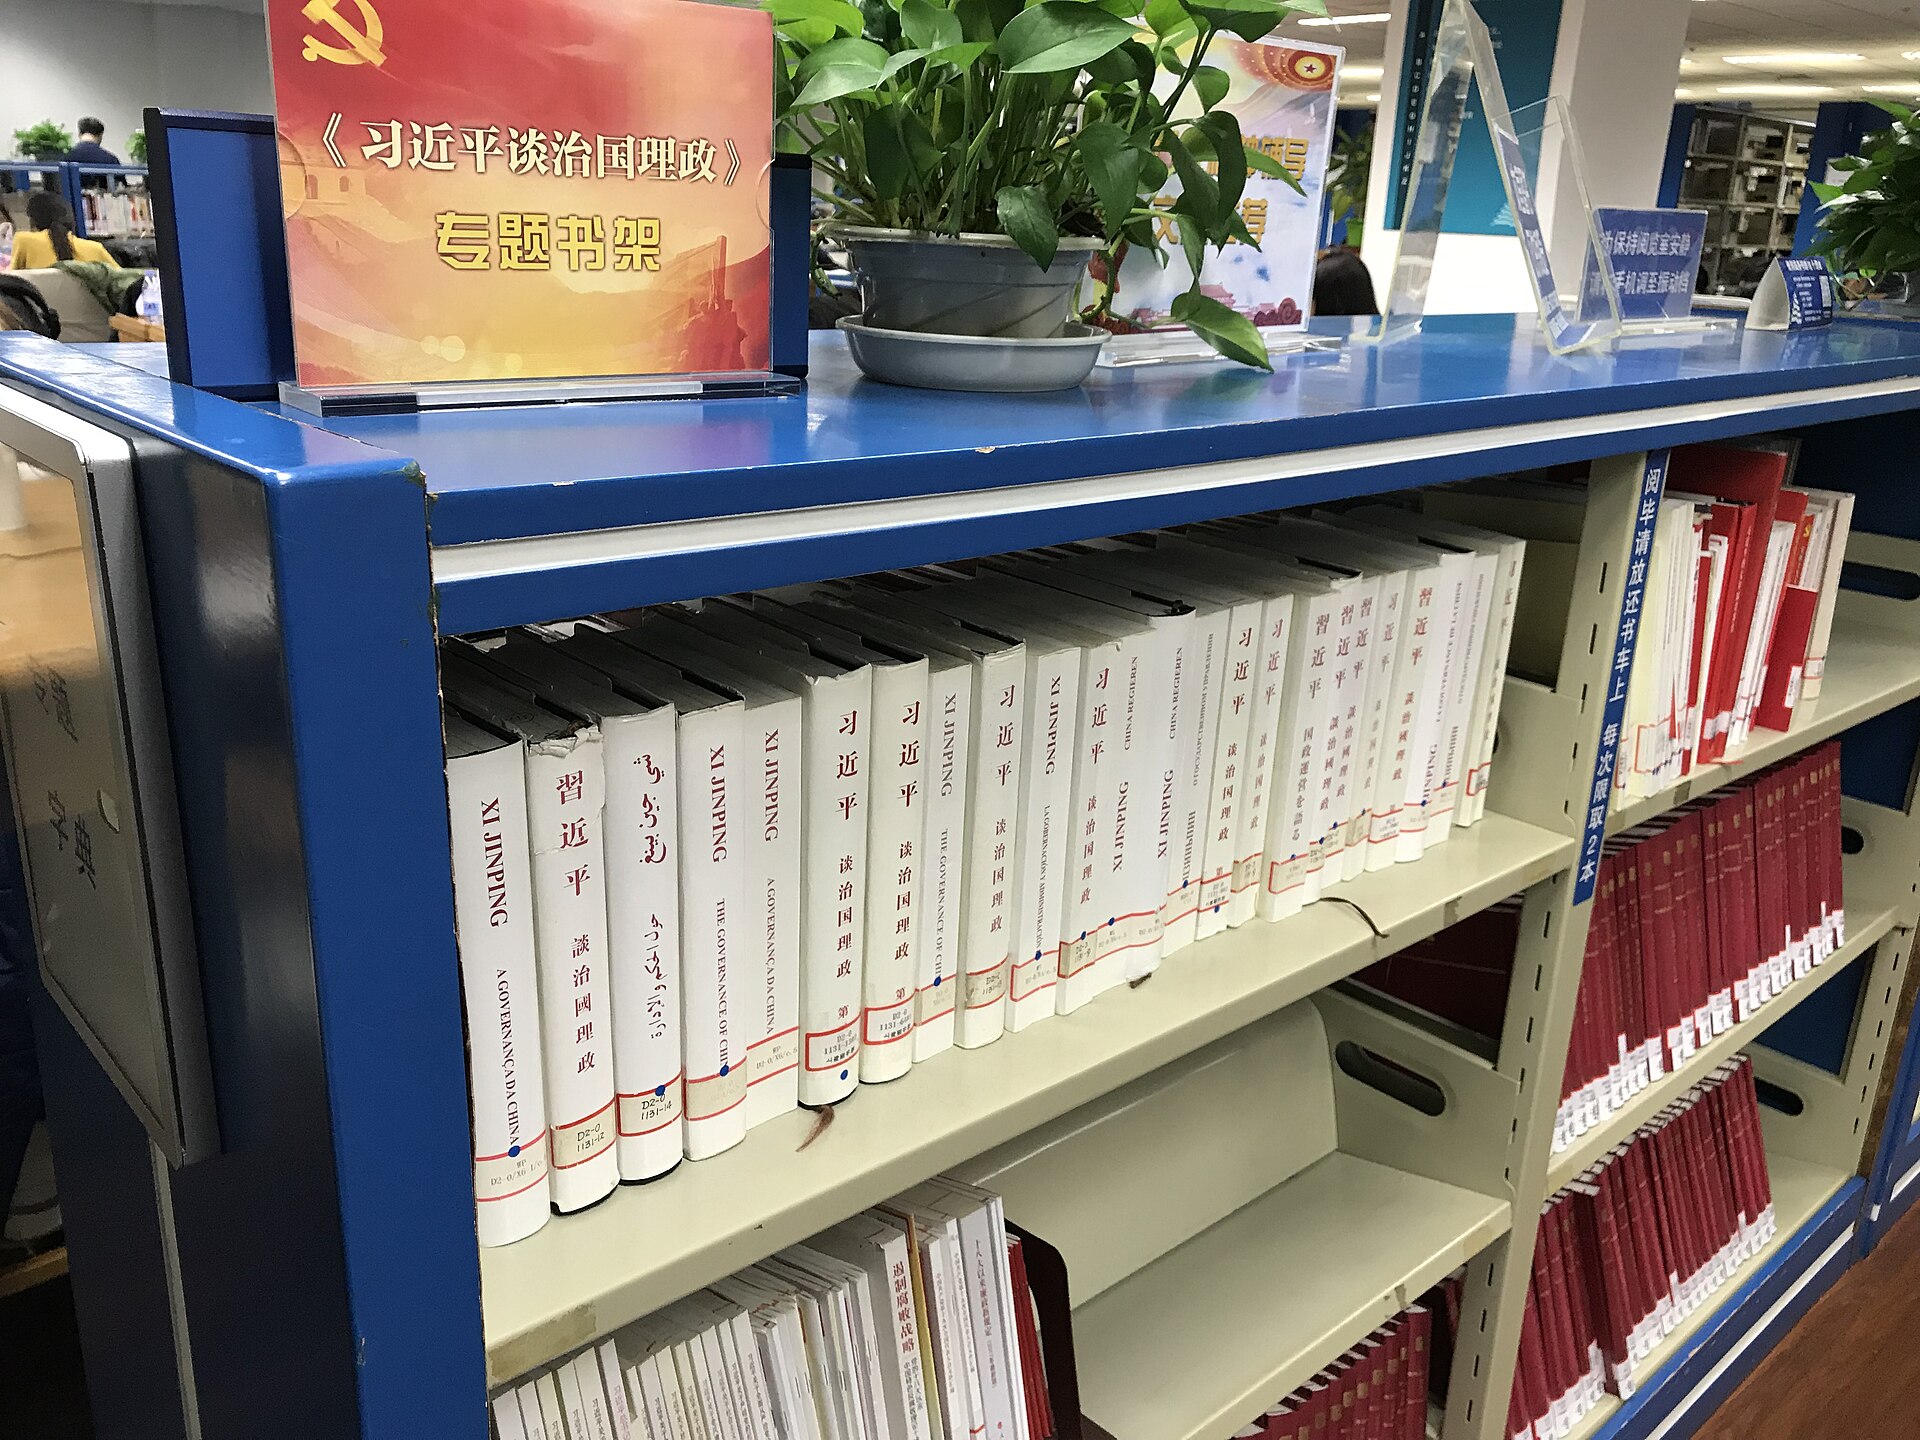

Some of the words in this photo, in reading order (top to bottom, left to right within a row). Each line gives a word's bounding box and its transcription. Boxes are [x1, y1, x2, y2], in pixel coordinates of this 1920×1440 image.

[321, 112, 742, 187] 《习近平谈治国理政》
[435, 210, 662, 272] 专题书架
[1411, 586, 1433, 666] 習近平
[1609, 468, 1662, 703] 阅毕请放还书车上
[1233, 627, 1253, 715] 习近平
[1264, 618, 1284, 705] 习近平
[1309, 613, 1330, 700] 習近平
[1335, 604, 1355, 689] 習近平
[1353, 596, 1373, 680] 習近平
[945, 692, 957, 715] XI
[1050, 675, 1062, 697] XI
[1091, 668, 1110, 765] 习近平
[710, 744, 725, 771] XI
[765, 728, 779, 753] XI
[835, 710, 859, 821] 习近平
[897, 700, 921, 808] 习近平
[940, 721, 956, 797] JINPING
[995, 684, 1016, 787] 习近平
[1045, 702, 1060, 776] JINPING
[481, 797, 501, 827] XI
[556, 769, 591, 896] 習近平
[711, 776, 728, 864] JINPING
[764, 759, 779, 842] JINPING
[1113, 781, 1130, 851] JINPING
[1159, 769, 1174, 843] JINPING
[1218, 742, 1238, 842] 谈治国理政
[1578, 723, 1620, 884] 每次限取2本
[483, 830, 509, 928] JINPING
[940, 828, 949, 854] THE
[990, 818, 1007, 933] 谈治国理政
[1080, 795, 1097, 905] 谈治国理政
[1113, 855, 1124, 873] XI
[1157, 842, 1168, 860] XI
[716, 898, 726, 927] THE
[766, 888, 776, 975] GOVERNANÇA
[836, 855, 854, 978] 谈治国理政
[894, 840, 914, 961] 谈治国理政
[936, 855, 949, 937] GOVERNANCE
[571, 934, 596, 1075] 談治國理政
[716, 928, 728, 1015] GOVERNANCE
[497, 980, 517, 1077] GOVERNANÇA
[718, 1016, 728, 1036] OF
[766, 996, 776, 1035] CHINA
[506, 1101, 521, 1146] CHINA
[576, 1131, 606, 1153] 1131-12
[577, 1123, 601, 1143] D2-0
